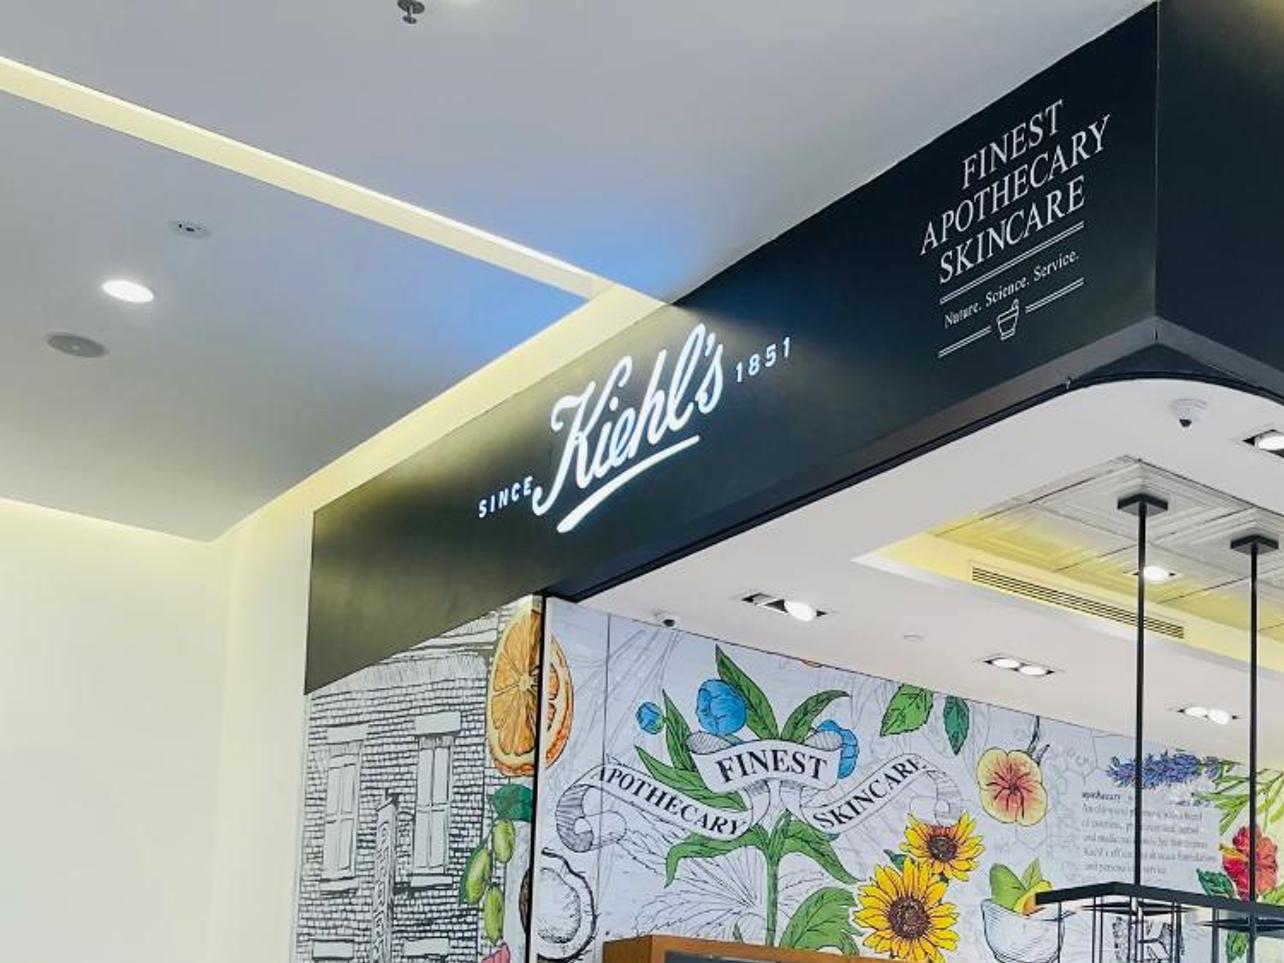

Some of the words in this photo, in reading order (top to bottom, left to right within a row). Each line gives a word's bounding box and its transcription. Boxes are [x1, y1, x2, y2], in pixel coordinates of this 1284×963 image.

[920, 113, 1110, 255] APOTHECARY
[961, 99, 1063, 190] FINEST
[939, 174, 1085, 284] SKINCARE
[944, 305, 982, 329] Nature.
[985, 276, 1030, 308] Science.
[1033, 250, 1080, 281] Service.
[478, 475, 534, 519] SINCE
[531, 322, 724, 517] Kiehl's
[734, 336, 791, 384] 1851
[594, 765, 748, 836] APOTHECARY
[715, 749, 828, 784] FINEST
